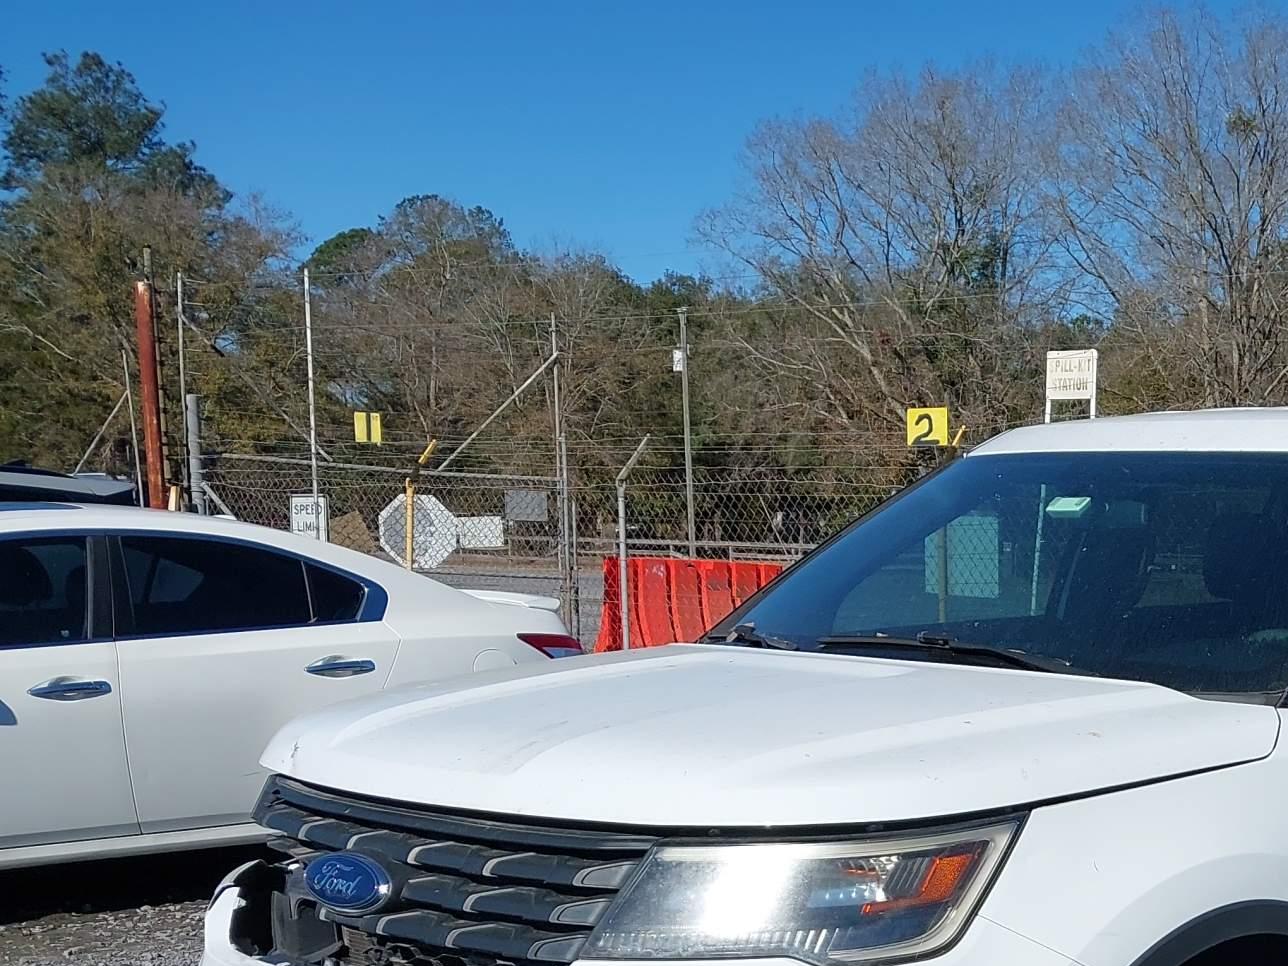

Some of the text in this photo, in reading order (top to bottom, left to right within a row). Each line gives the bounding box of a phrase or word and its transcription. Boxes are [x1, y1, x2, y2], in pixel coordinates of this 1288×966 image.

[911, 413, 941, 446] 2
[297, 520, 318, 532] LIMI
[313, 861, 362, 897] Ford
